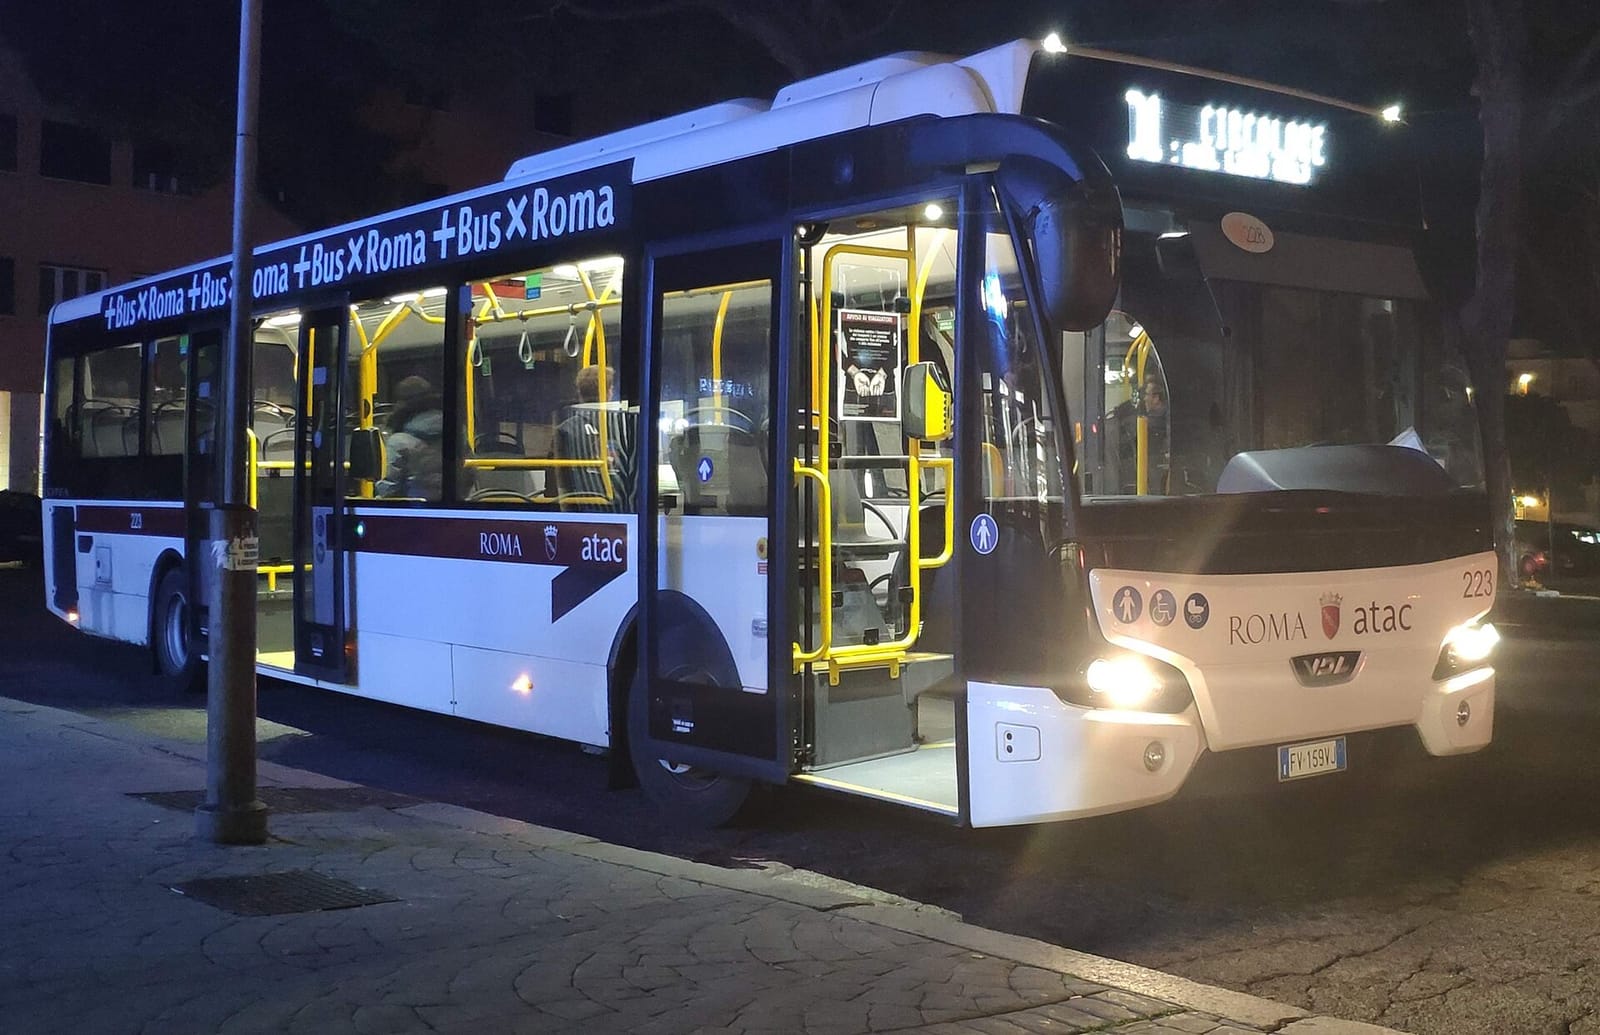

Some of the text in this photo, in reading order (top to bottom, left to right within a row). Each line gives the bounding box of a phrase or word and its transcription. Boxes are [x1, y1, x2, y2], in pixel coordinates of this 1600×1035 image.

[130, 513, 142, 529] 223
[480, 532, 623, 563] ROMA atac
[1462, 570, 1493, 598] 223
[1229, 601, 1412, 645] ROMA atac
[1303, 655, 1349, 677] VDL
